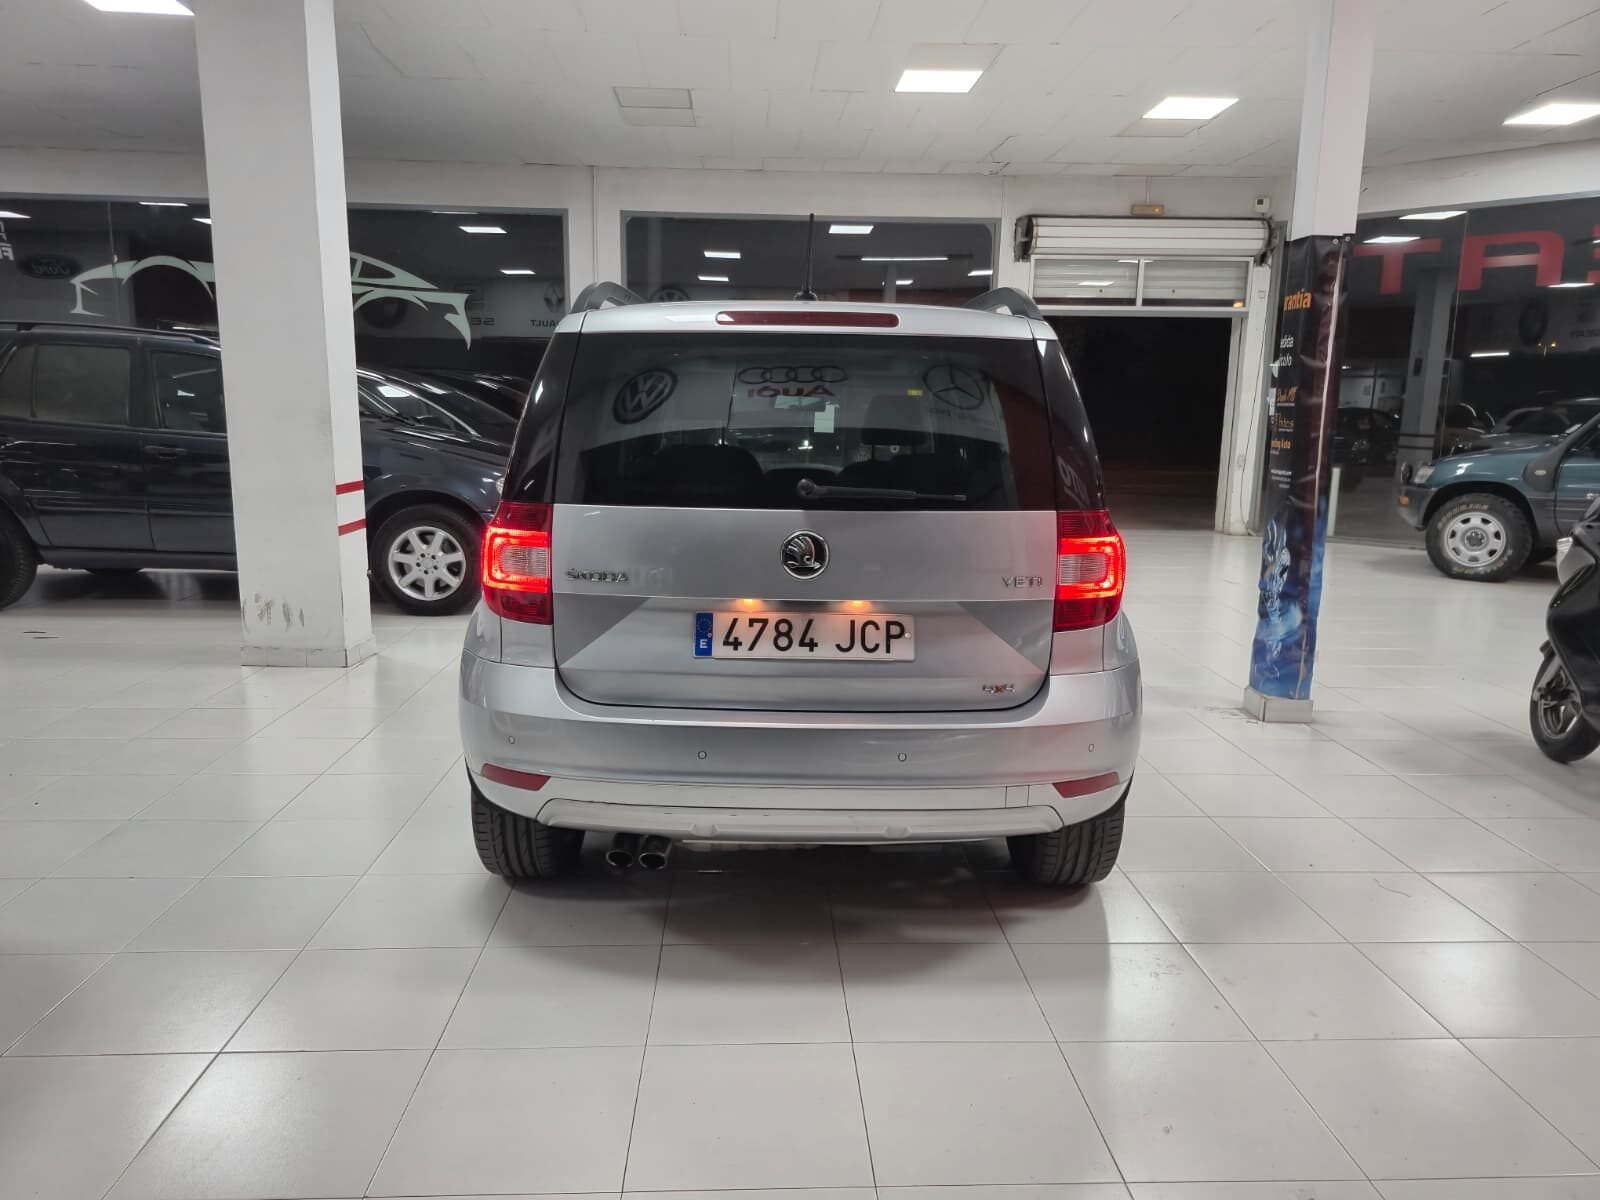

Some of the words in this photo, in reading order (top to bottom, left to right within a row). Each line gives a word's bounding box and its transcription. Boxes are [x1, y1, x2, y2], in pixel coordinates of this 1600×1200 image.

[1002, 576, 1043, 589] YETI
[722, 617, 818, 653] 4784
[835, 619, 905, 654] JCP
[699, 638, 709, 649] E
